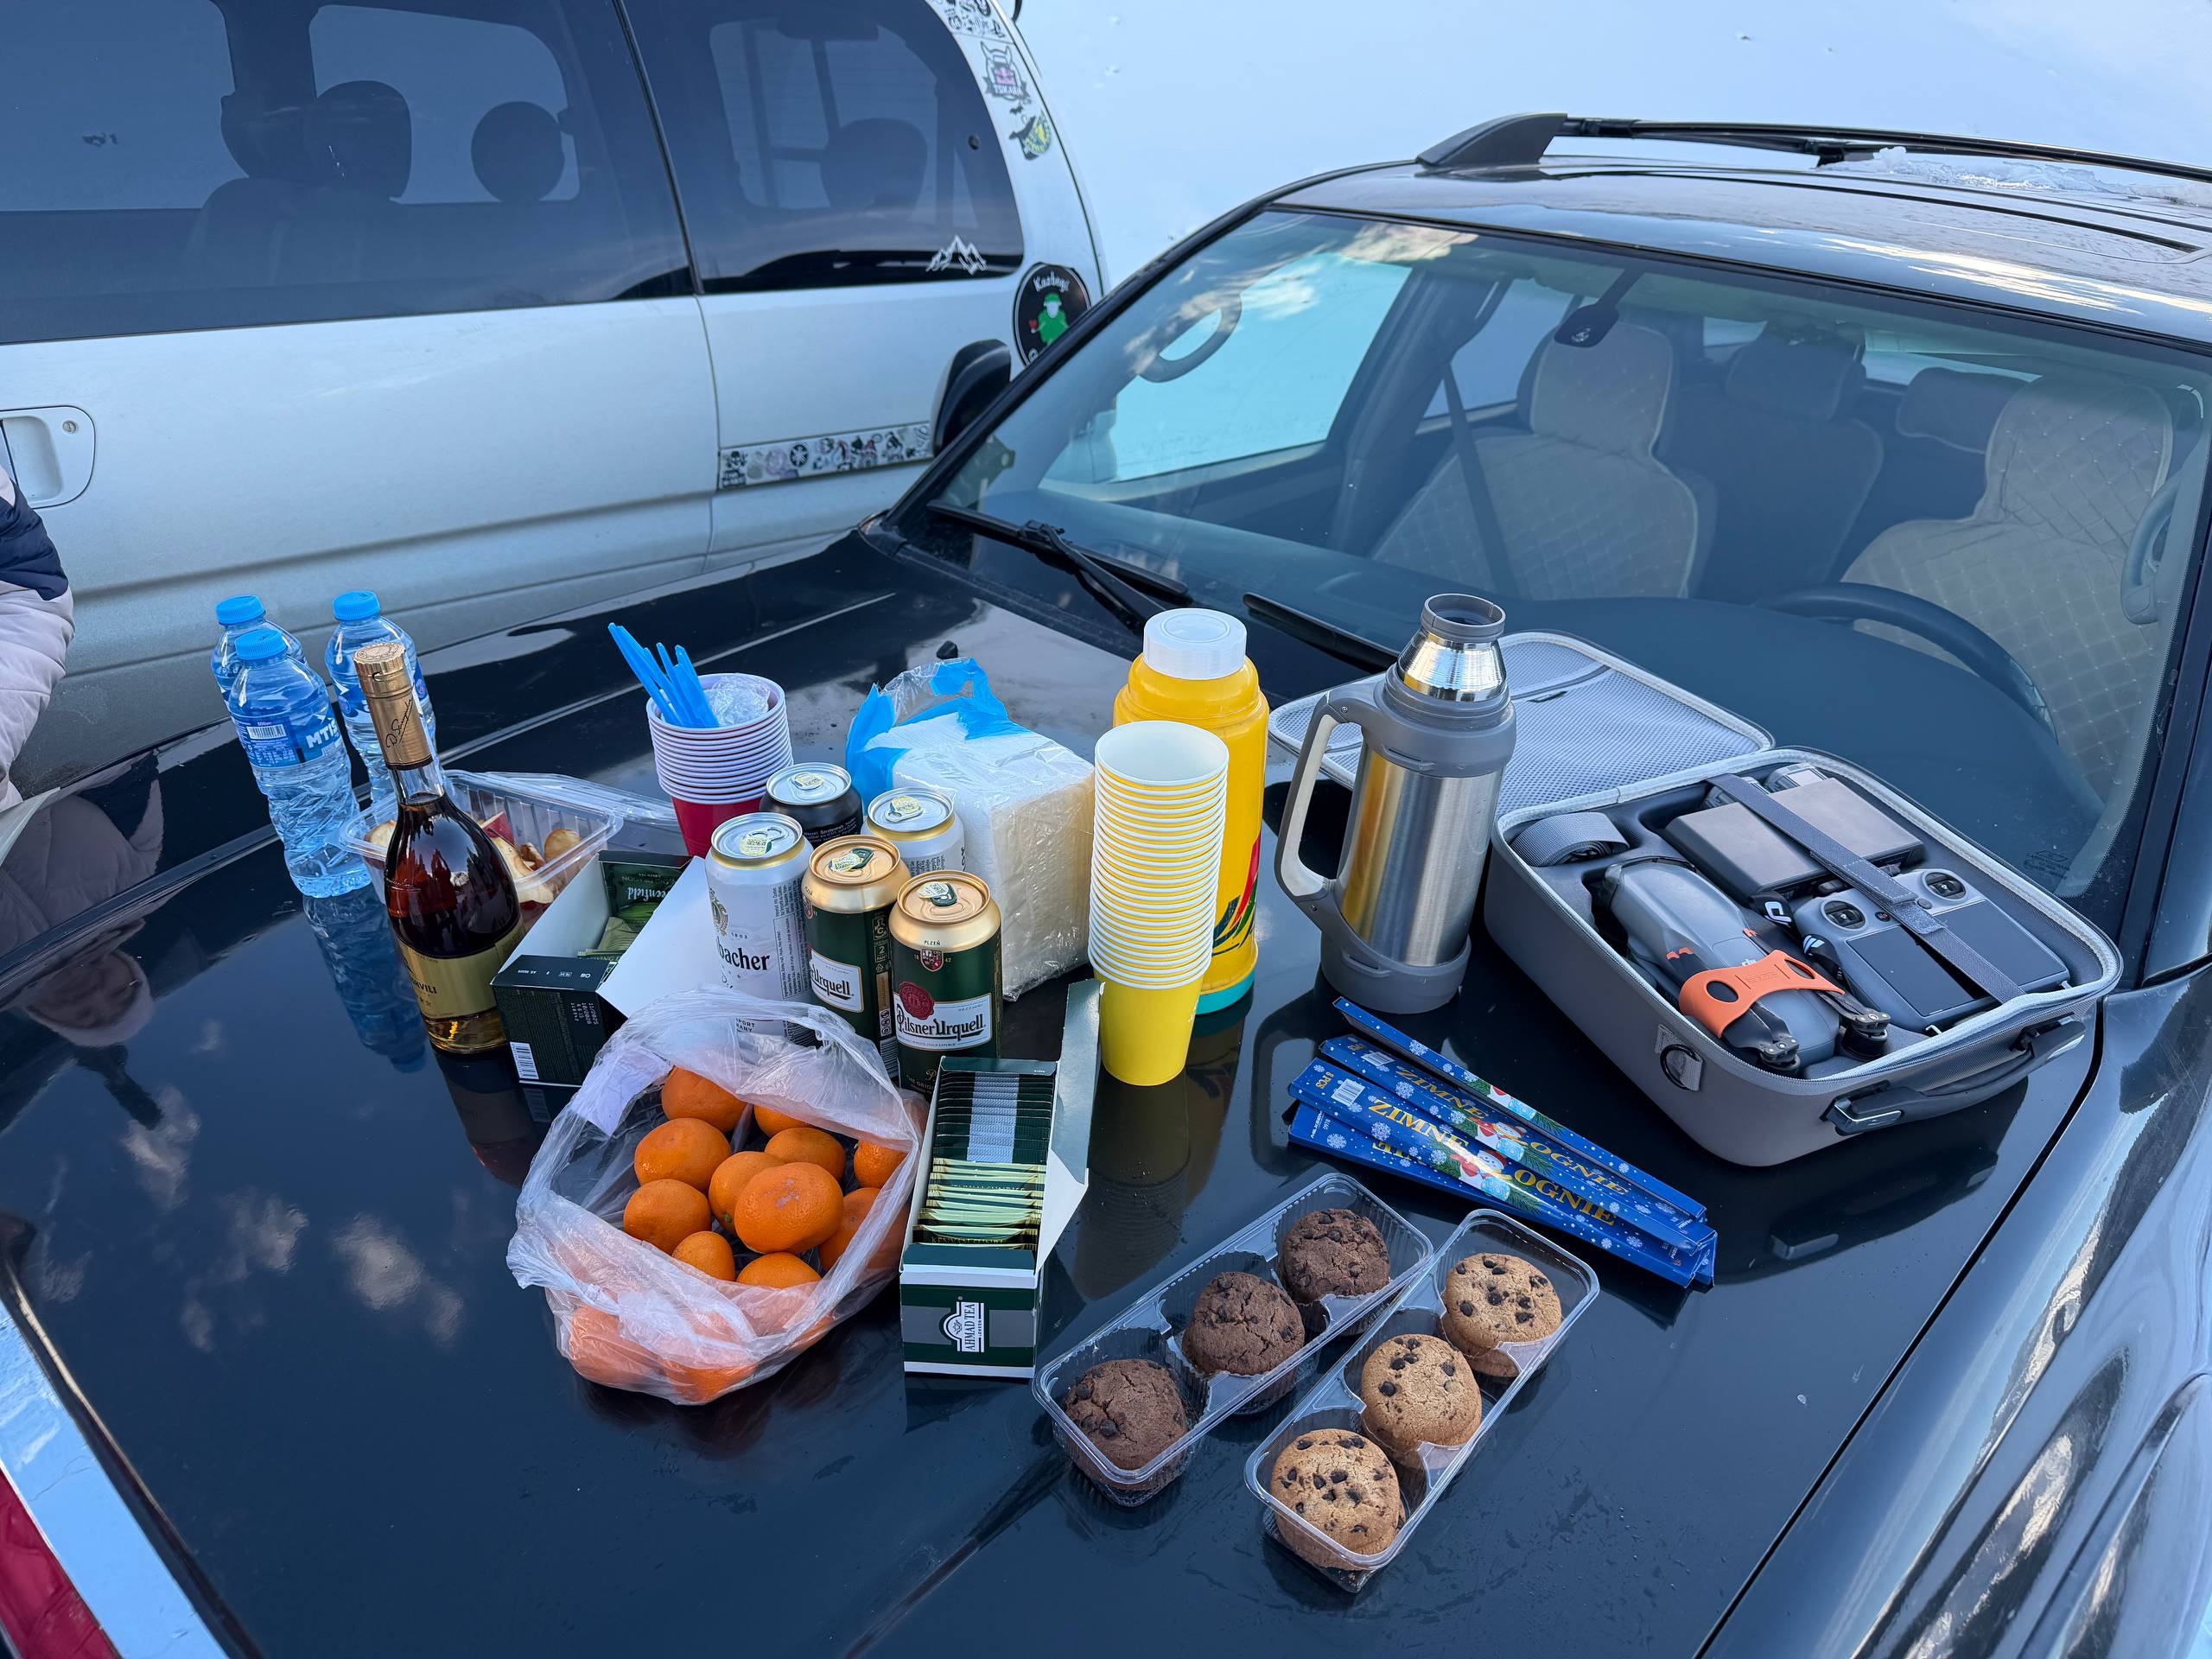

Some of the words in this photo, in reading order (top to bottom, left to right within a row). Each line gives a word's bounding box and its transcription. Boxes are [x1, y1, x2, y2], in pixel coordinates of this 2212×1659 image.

[627, 887, 666, 901] eenfield
[1315, 1075, 1332, 1090] PCS
[1395, 1065, 1490, 1119] ZIMNE
[1529, 1141, 1629, 1196] OGNIE
[1368, 1098, 1470, 1151] ZIMNE
[1514, 1169, 1618, 1227] OGNIE
[963, 1303, 976, 1320] TEA
[963, 1320, 976, 1351] AHMAD
